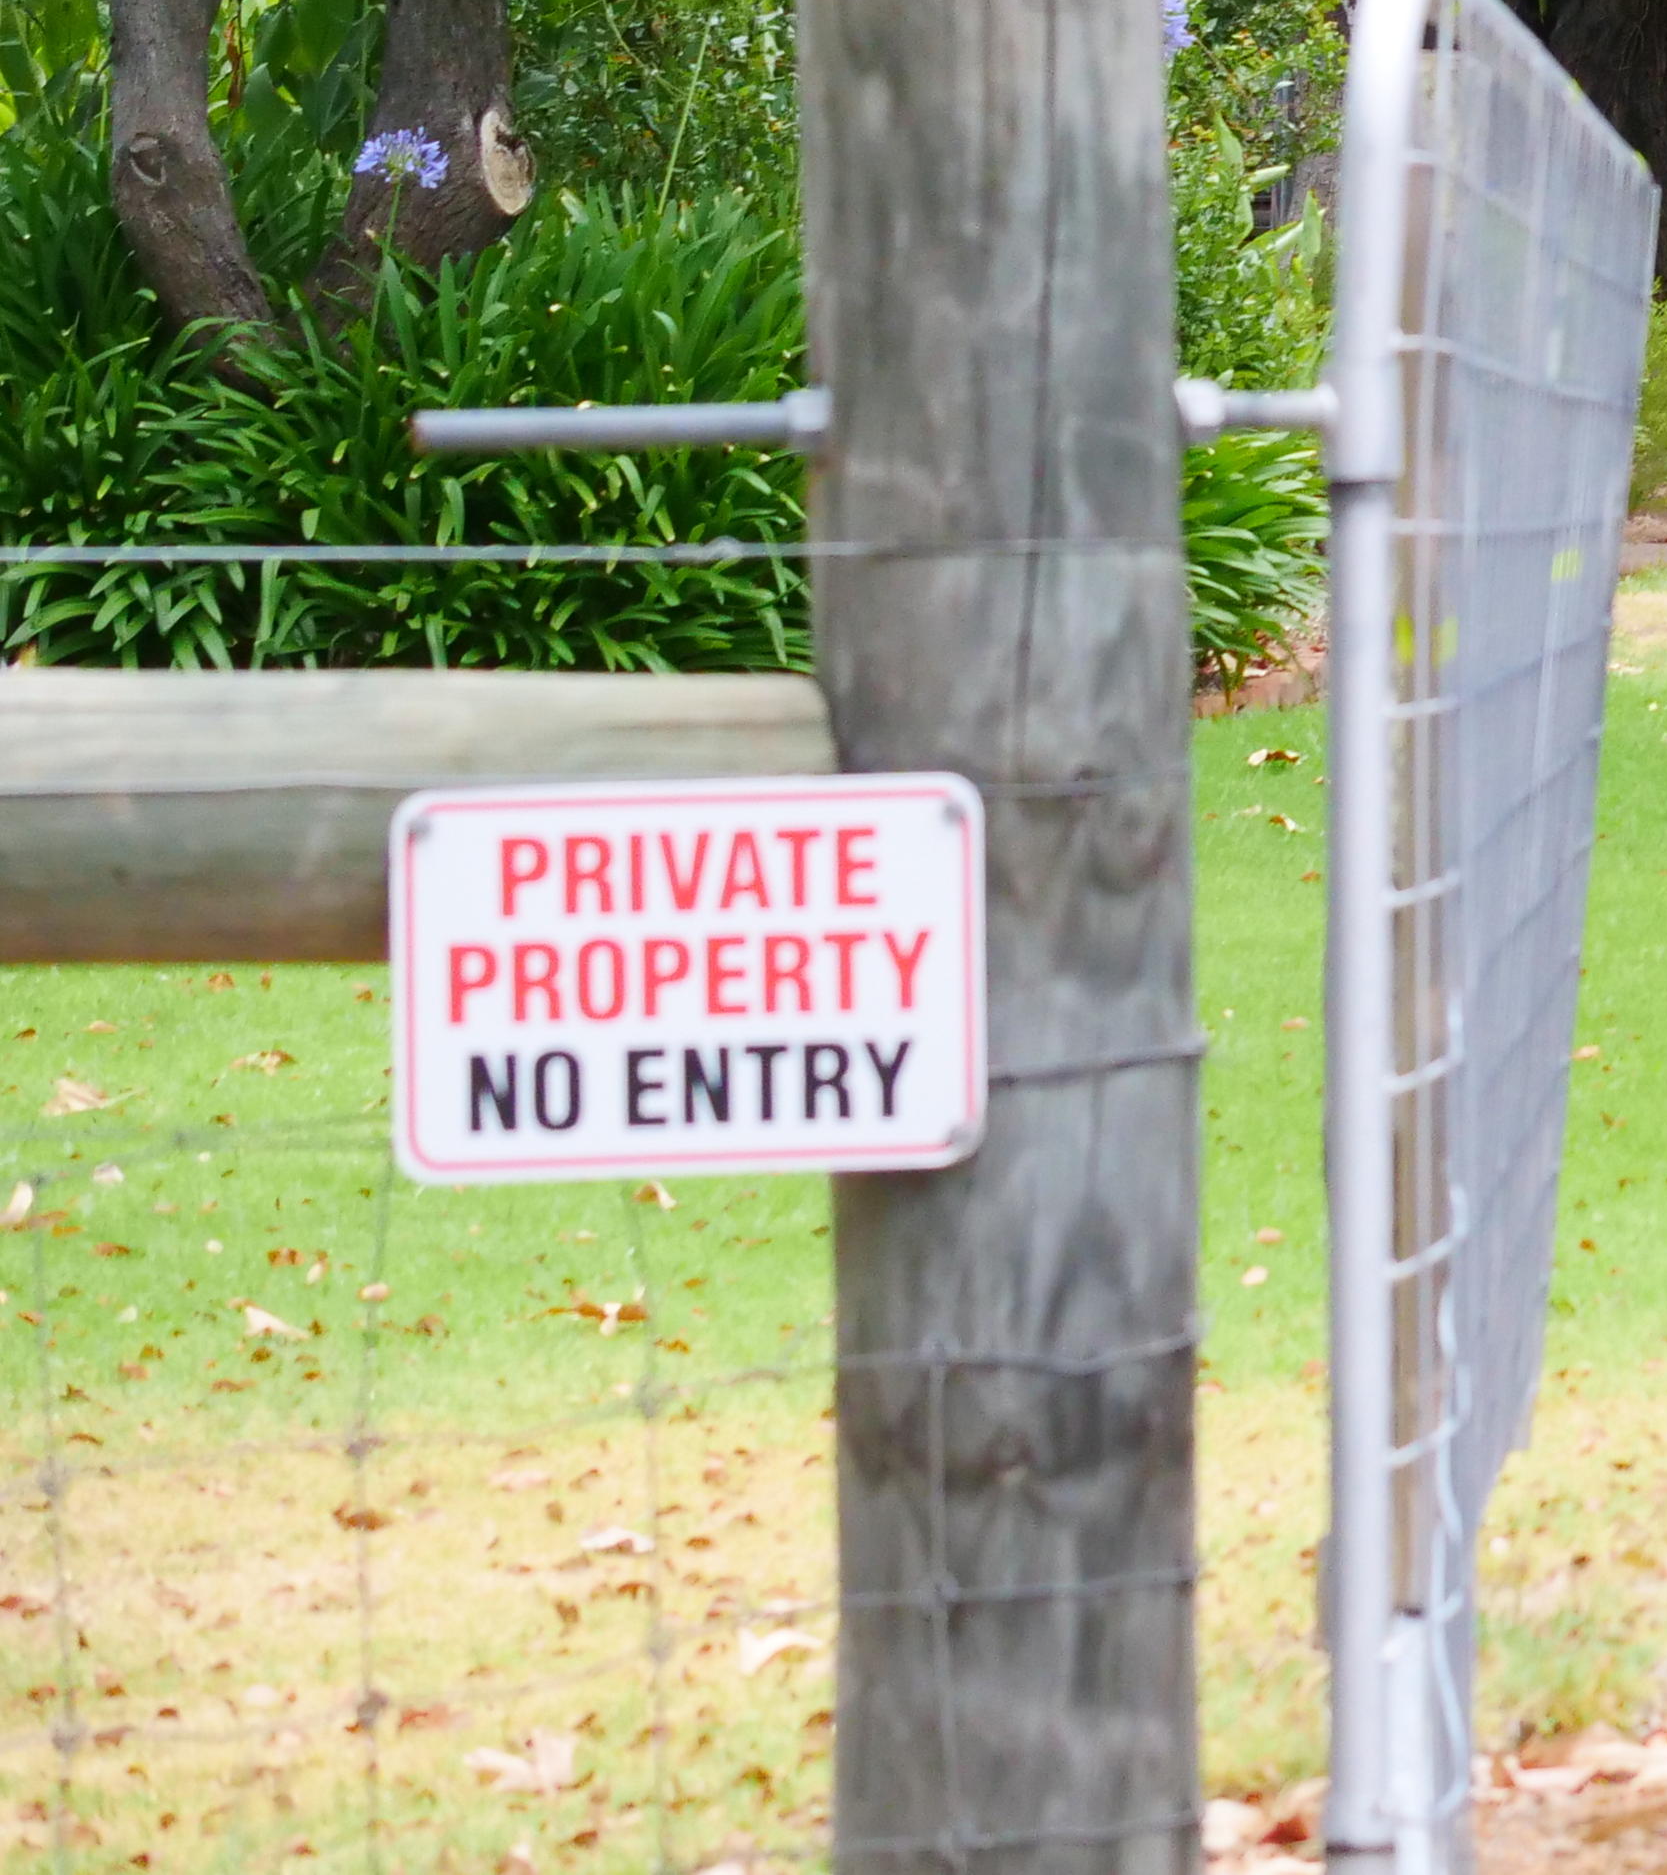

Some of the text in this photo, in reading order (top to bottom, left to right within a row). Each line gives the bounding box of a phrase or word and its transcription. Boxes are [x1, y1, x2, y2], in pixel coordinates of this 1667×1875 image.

[501, 827, 877, 916] PRIVATE
[449, 931, 929, 1023] PROPERTY
[470, 1042, 910, 1131] NO ENTRY
